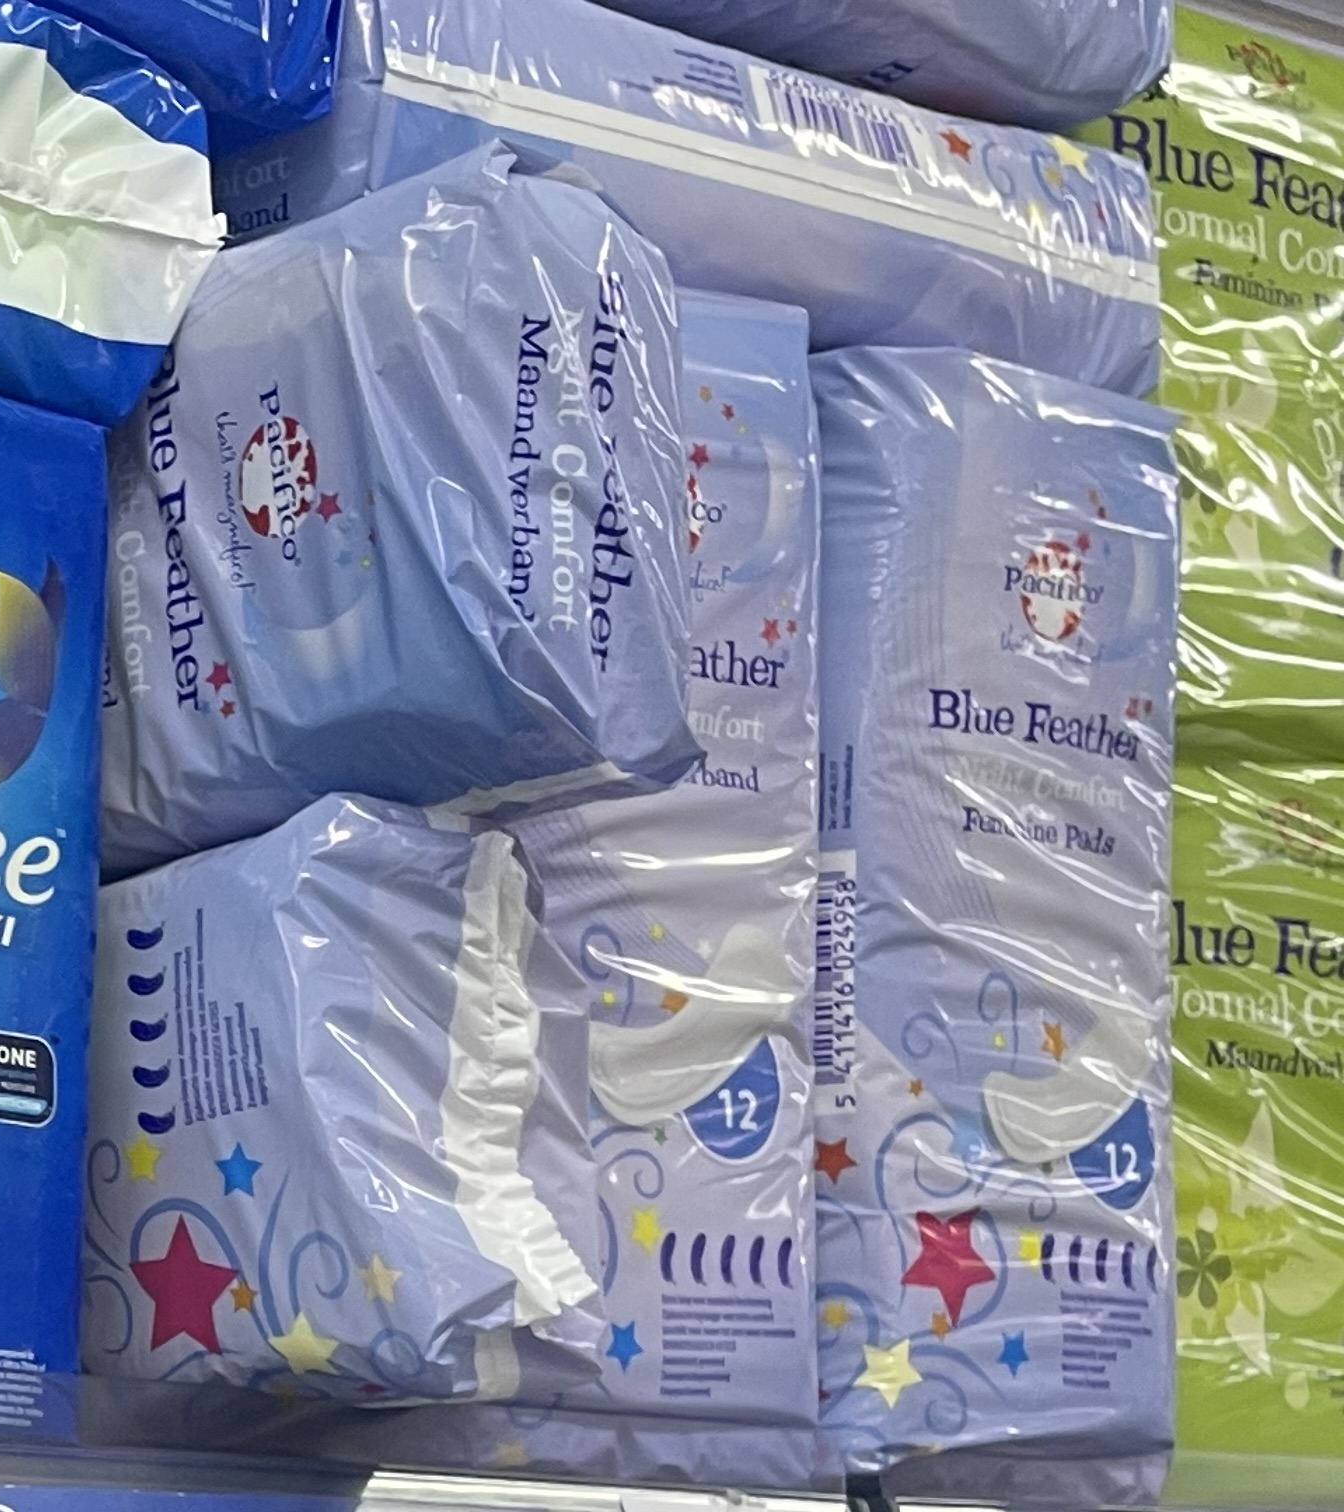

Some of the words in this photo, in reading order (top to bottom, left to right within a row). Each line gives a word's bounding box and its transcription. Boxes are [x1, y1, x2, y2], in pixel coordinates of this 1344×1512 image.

[1107, 113, 1234, 193] Blue
[259, 384, 299, 561] Pacifico
[551, 444, 587, 632] Comfort
[158, 480, 203, 713] Feather
[928, 689, 1014, 736] Blue
[1023, 701, 1139, 762] Feather
[1065, 823, 1116, 857] Pads
[834, 879, 856, 970] 024958
[833, 982, 854, 1075] 411416
[718, 1089, 757, 1130] 12
[835, 1095, 854, 1108] 5
[1104, 1144, 1137, 1183] 12
